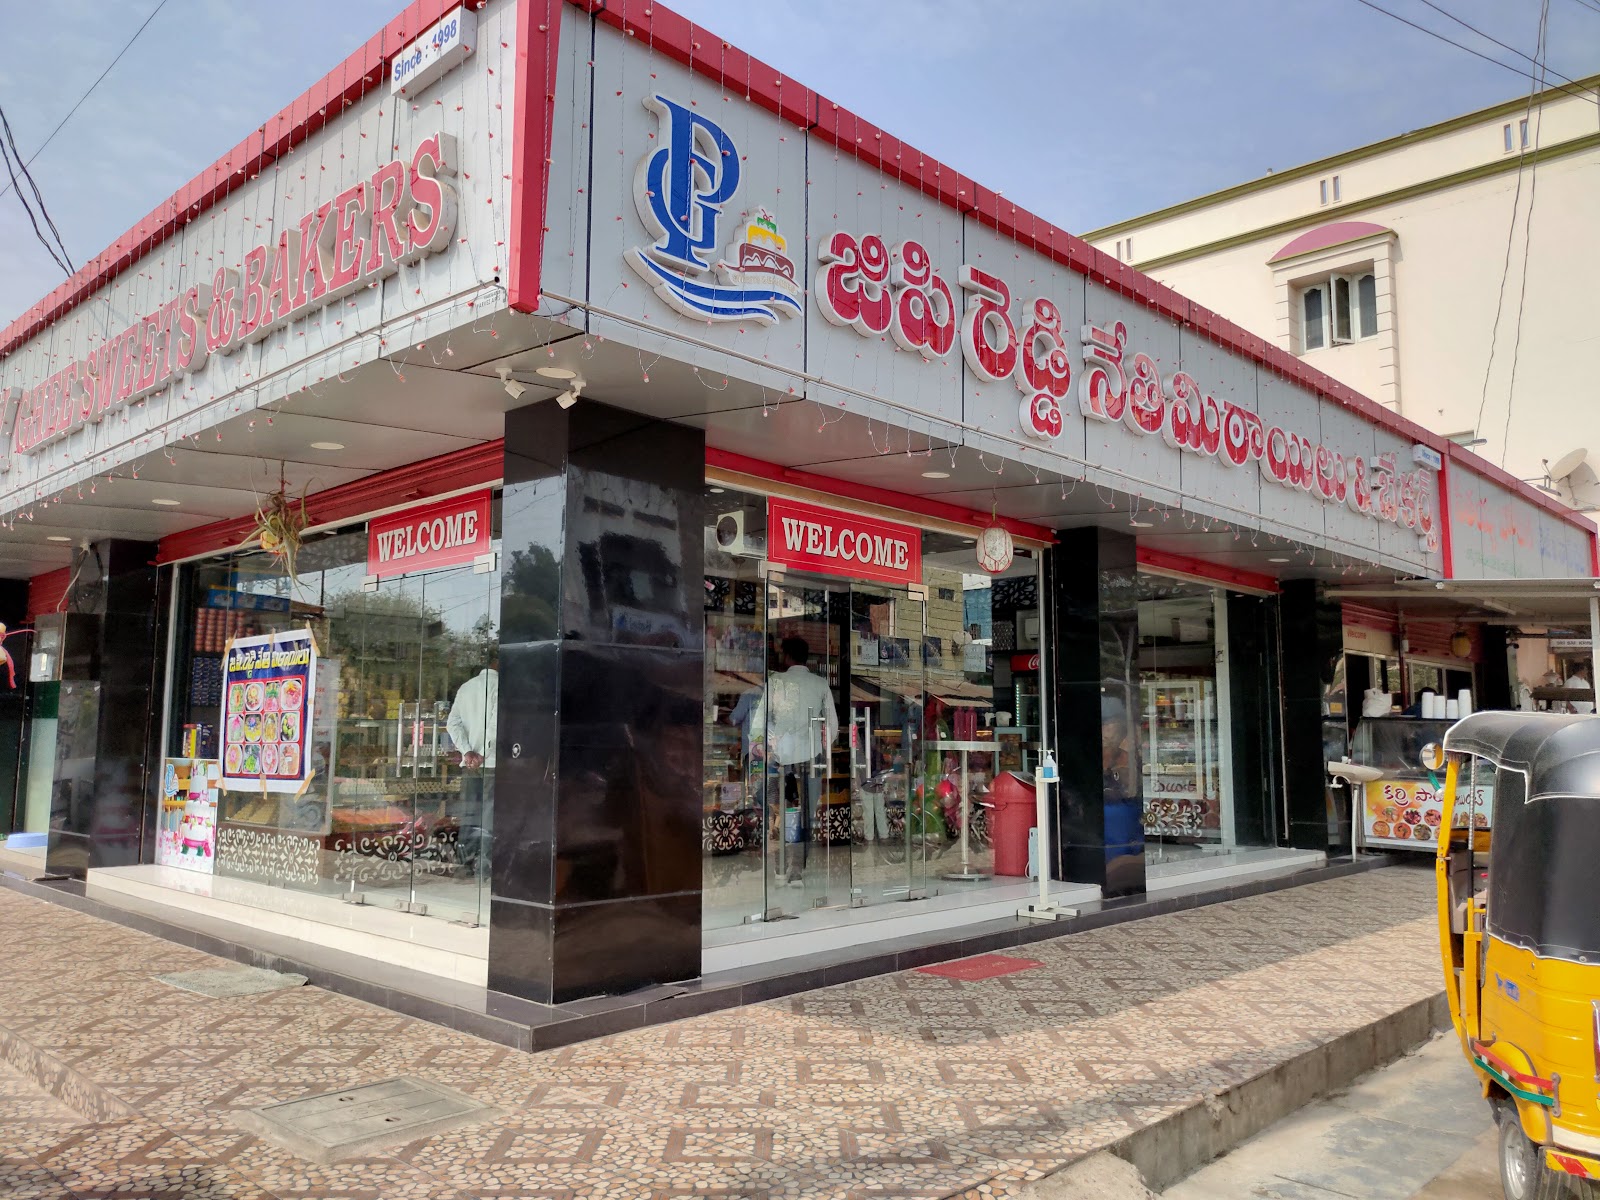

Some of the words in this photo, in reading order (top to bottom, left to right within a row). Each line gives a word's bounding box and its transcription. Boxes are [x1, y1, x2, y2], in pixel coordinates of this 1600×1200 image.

[394, 50, 422, 81] Since
[432, 19, 457, 52] 1998
[14, 359, 81, 456] GHEE
[78, 282, 203, 422] SWEETS
[205, 266, 238, 354] &
[237, 131, 453, 342] BAKERS
[377, 510, 478, 563] WELCOME
[781, 516, 909, 571] WELCOME
